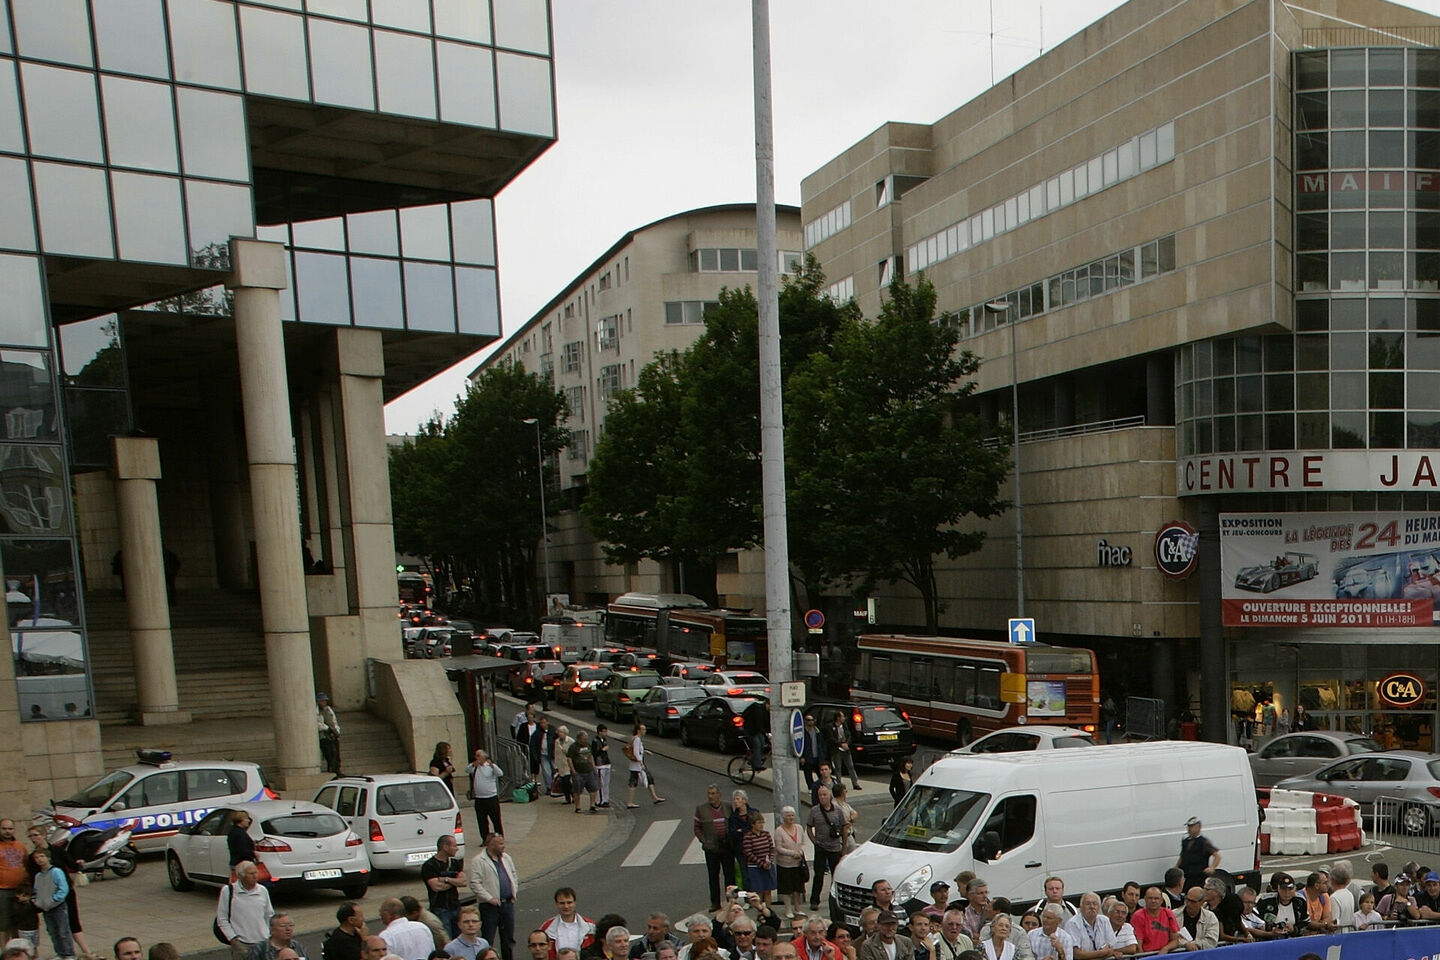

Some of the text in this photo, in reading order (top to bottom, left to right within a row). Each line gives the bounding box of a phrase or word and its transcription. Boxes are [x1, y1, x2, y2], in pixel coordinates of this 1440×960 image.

[1303, 173, 1432, 192] MAIF
[1186, 456, 1323, 491] CENTRE
[1222, 518, 1283, 528] EXPOSITION
[1284, 531, 1299, 545] LA
[1329, 520, 1401, 551] DES 24
[1405, 533, 1419, 545] DU
[1097, 539, 1132, 566] fnac
[1160, 537, 1190, 562] C&A
[1242, 602, 1412, 613] OUVERTURE EXCEPTIONNELLE!
[1240, 614, 1416, 625] LE DIMANCHE 5 JUIN 2011 (11H-18H)
[1386, 681, 1418, 698] C&A
